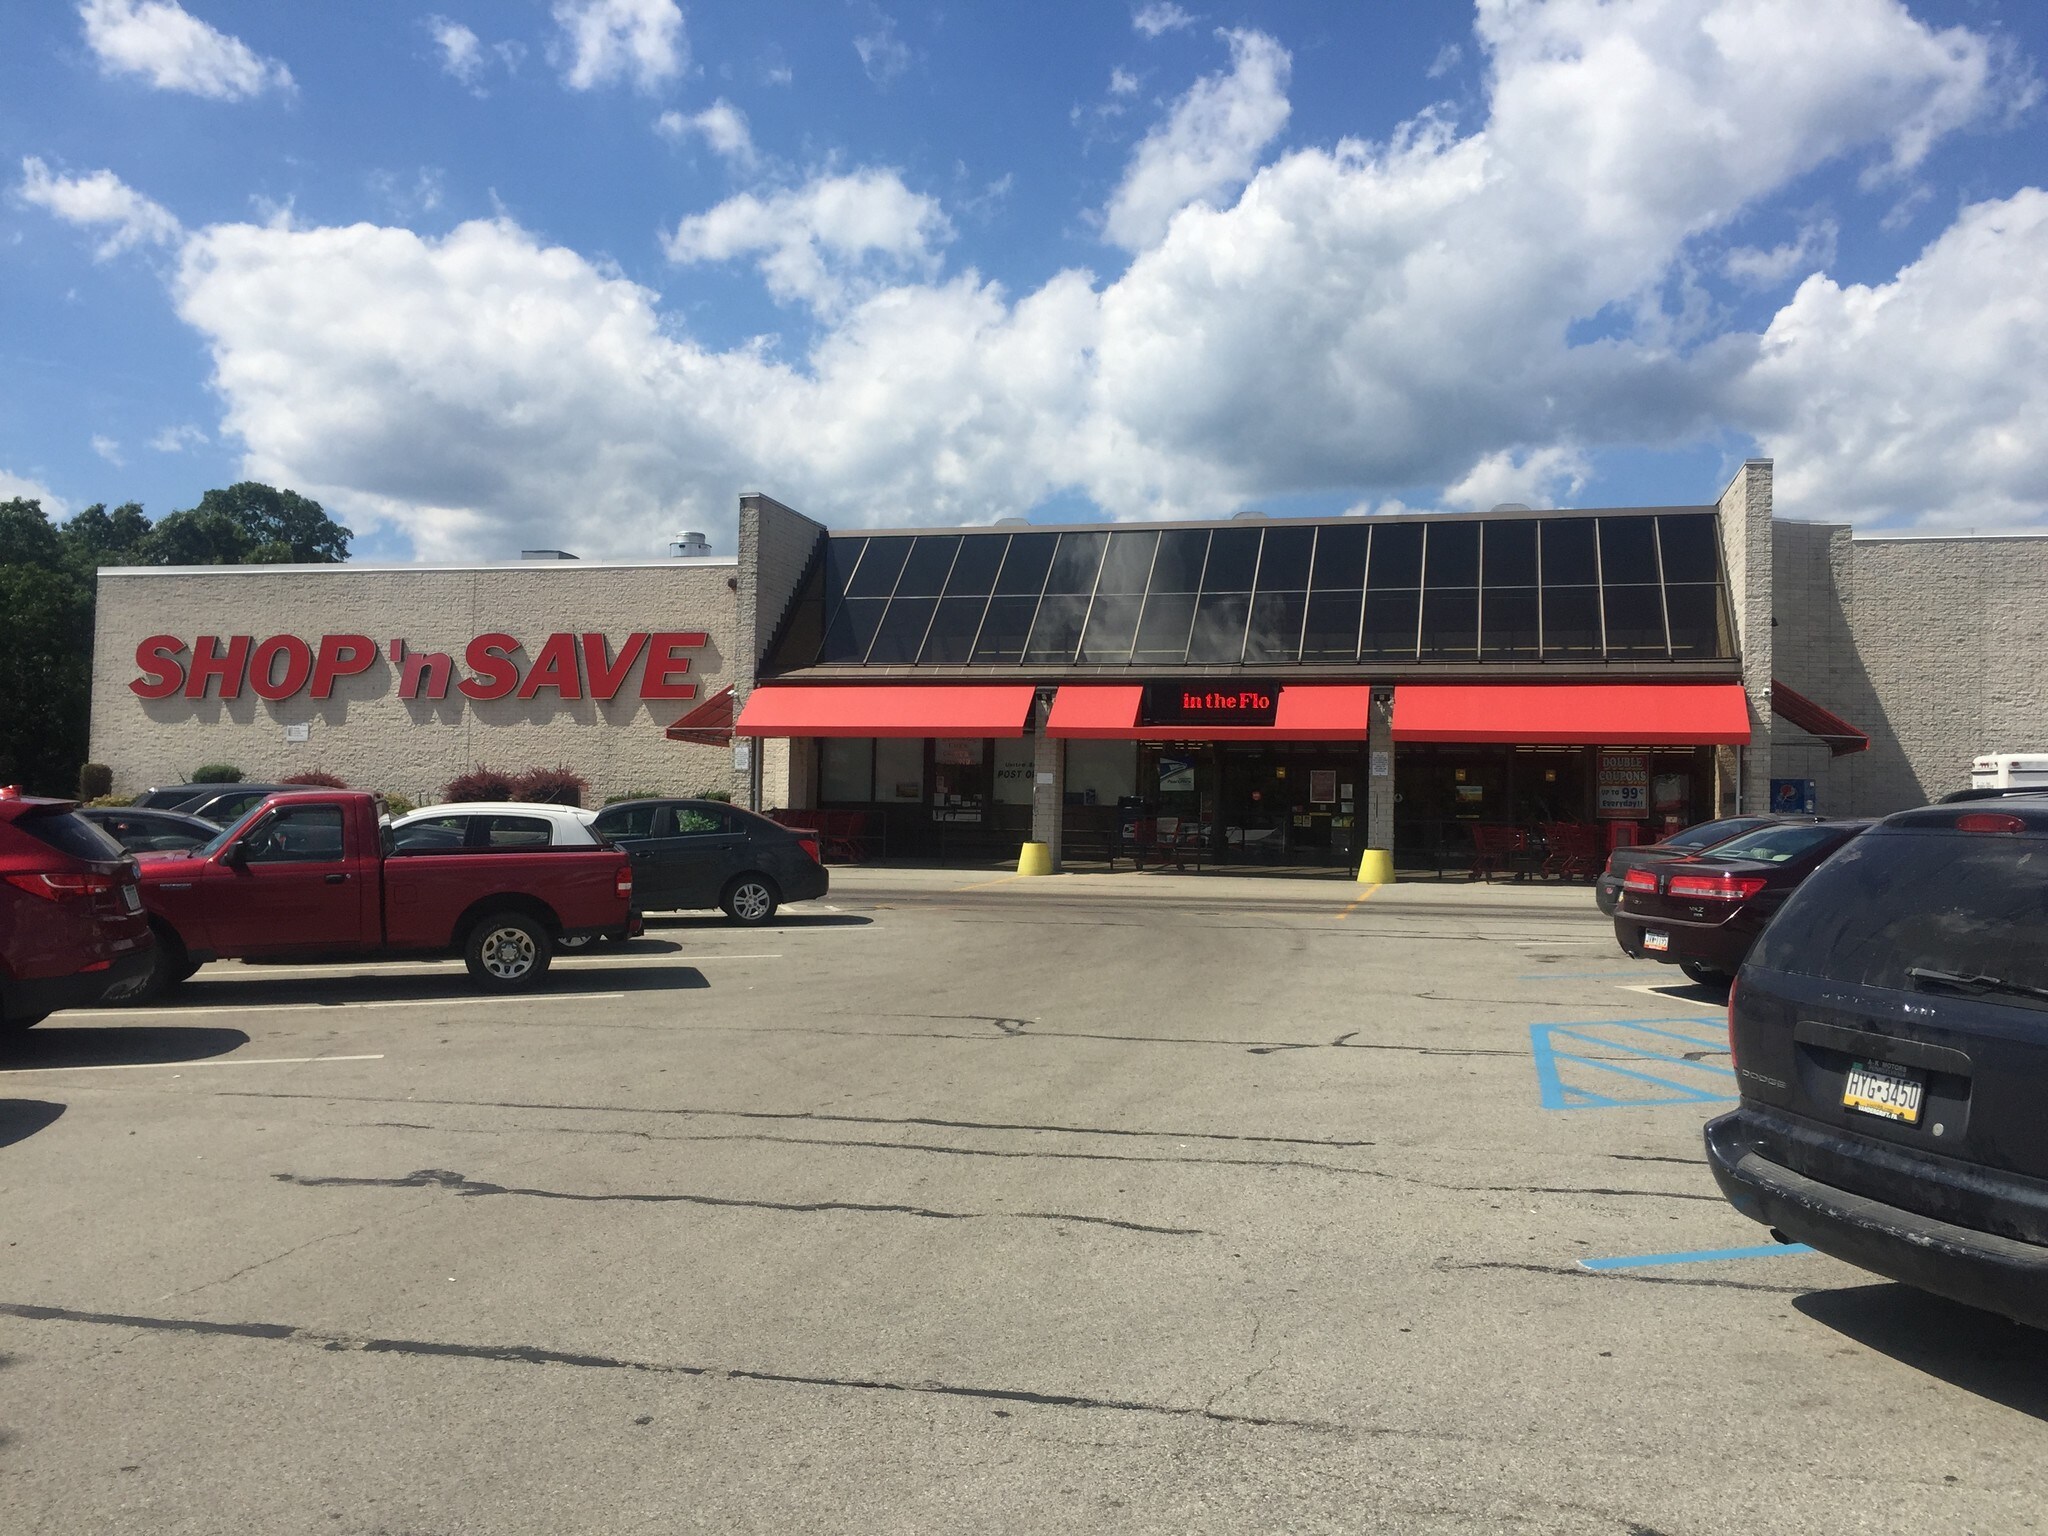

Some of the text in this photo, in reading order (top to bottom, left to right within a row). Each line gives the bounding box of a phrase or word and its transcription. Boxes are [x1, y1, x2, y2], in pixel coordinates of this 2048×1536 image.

[128, 634, 377, 700] SHOP
[457, 633, 708, 700] SAVE
[1183, 693, 1270, 709] in the Flo
[1603, 757, 1643, 768] DOUBLE
[998, 770, 1021, 779] POST
[1599, 770, 1648, 782] COUPONS
[1742, 1069, 1787, 1089] DODGE
